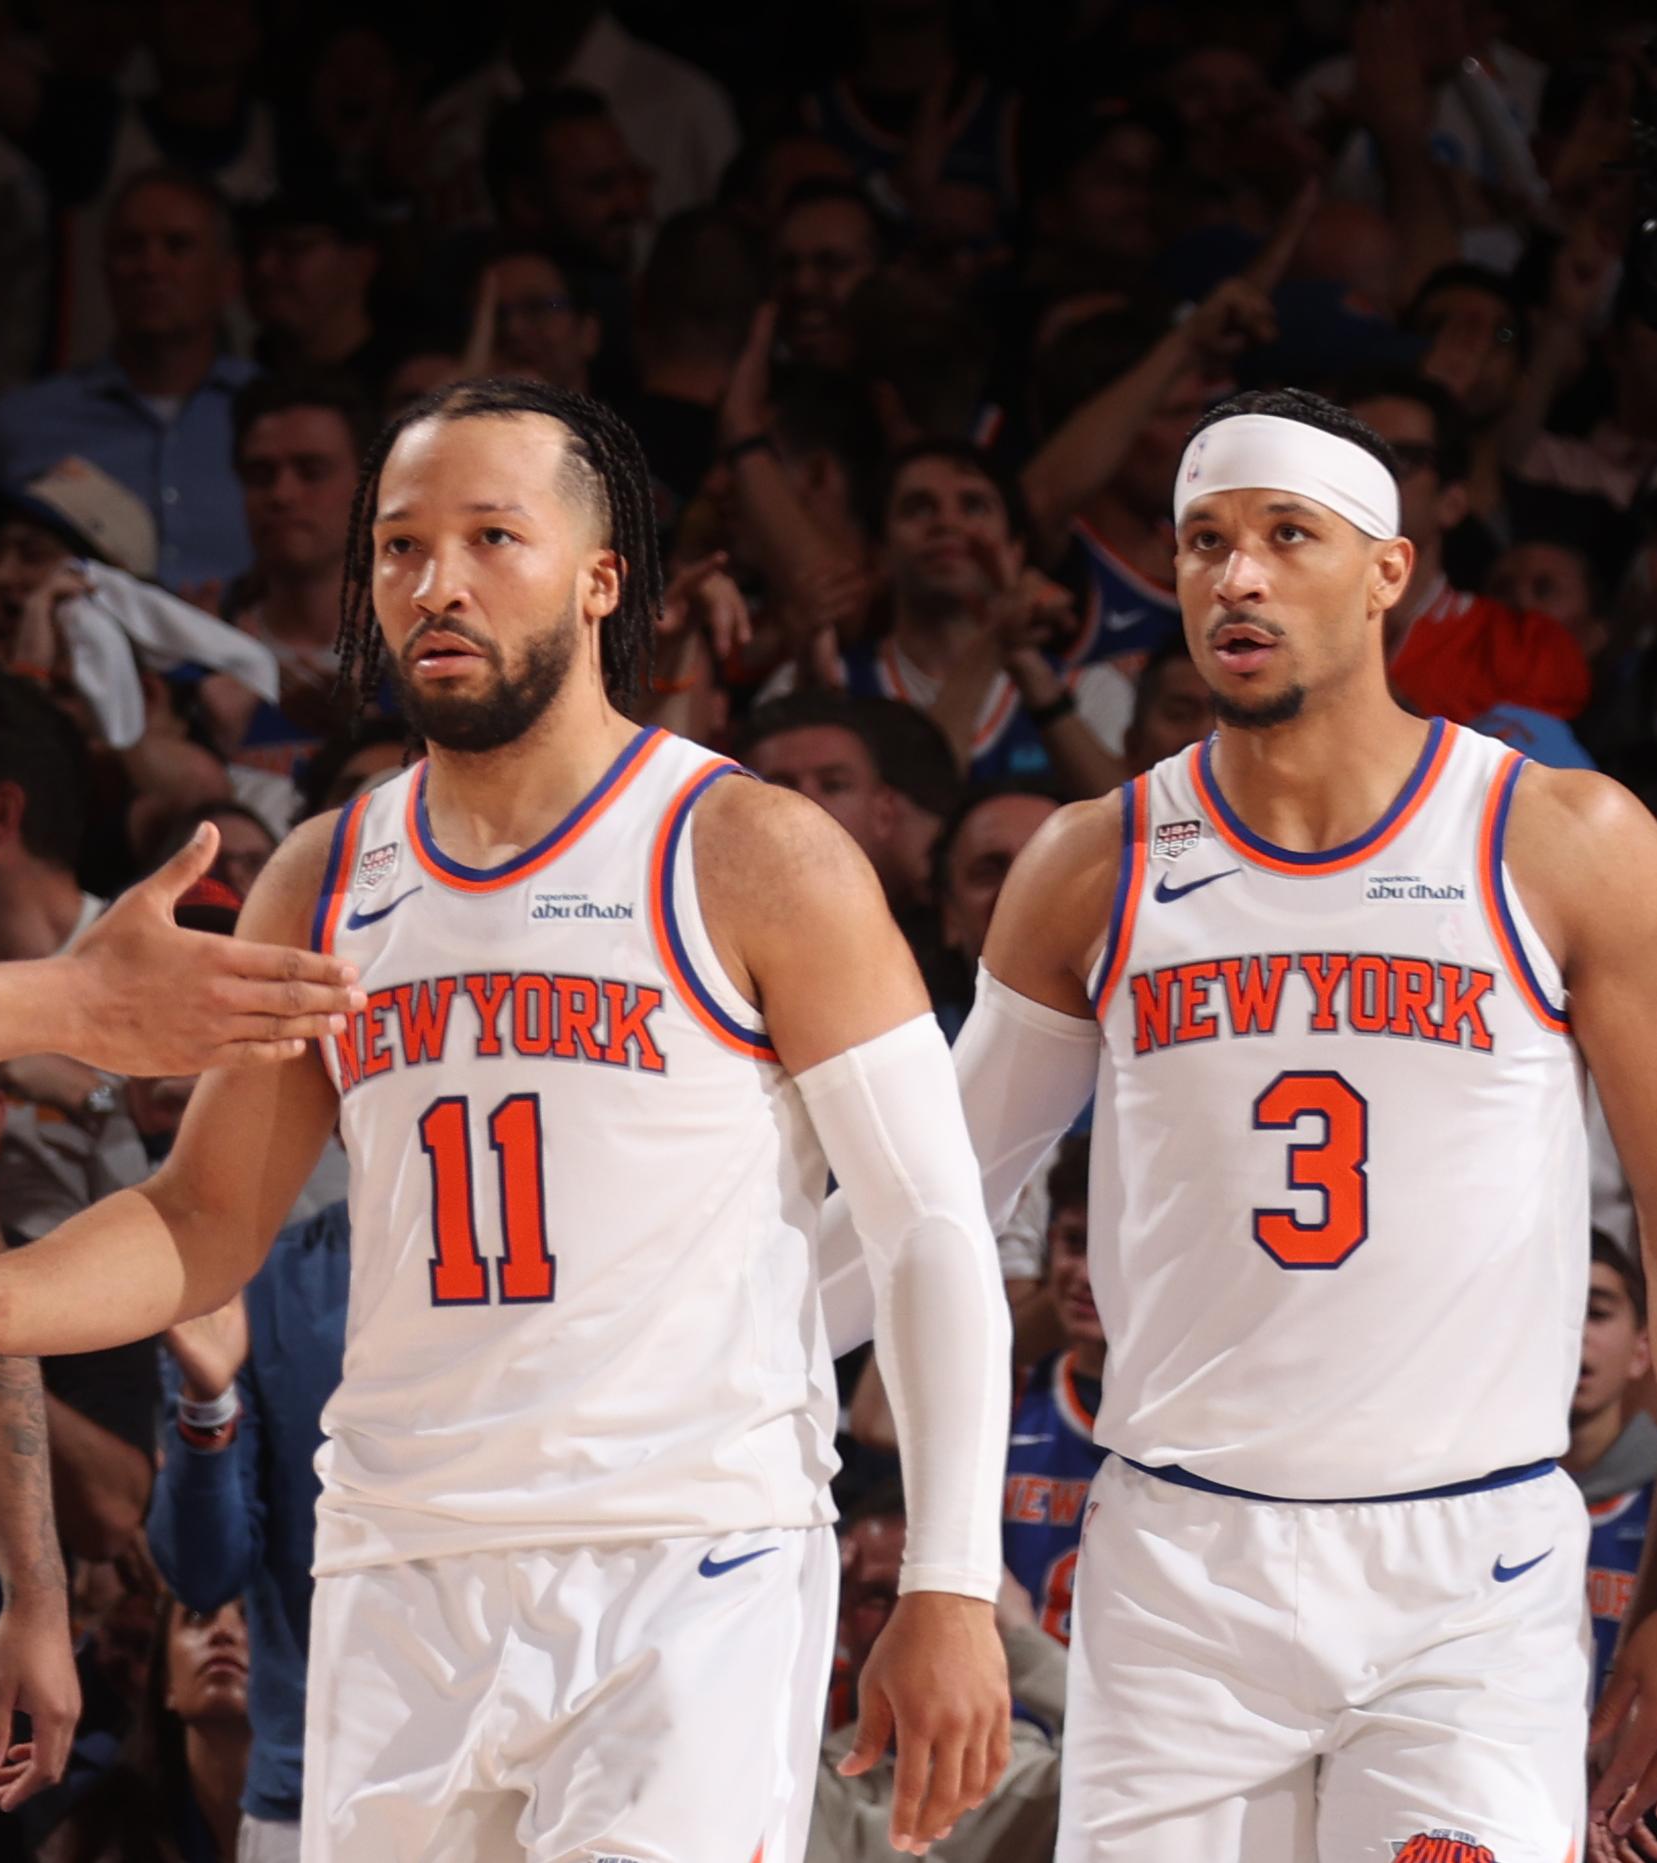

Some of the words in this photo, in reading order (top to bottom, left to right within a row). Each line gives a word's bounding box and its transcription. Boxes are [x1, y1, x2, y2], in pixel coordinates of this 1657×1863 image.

[1158, 823, 1199, 837] USA
[532, 903, 571, 919] abu
[574, 902, 633, 919] dhabi
[1366, 885, 1404, 900] abu
[1407, 884, 1466, 900] dhabi
[335, 974, 458, 1096] NEW
[464, 972, 667, 1075] YORK
[1129, 953, 1292, 1057] NEW
[1299, 952, 1495, 1055] YORK
[418, 1092, 557, 1307] 11
[1252, 1071, 1368, 1269] 3
